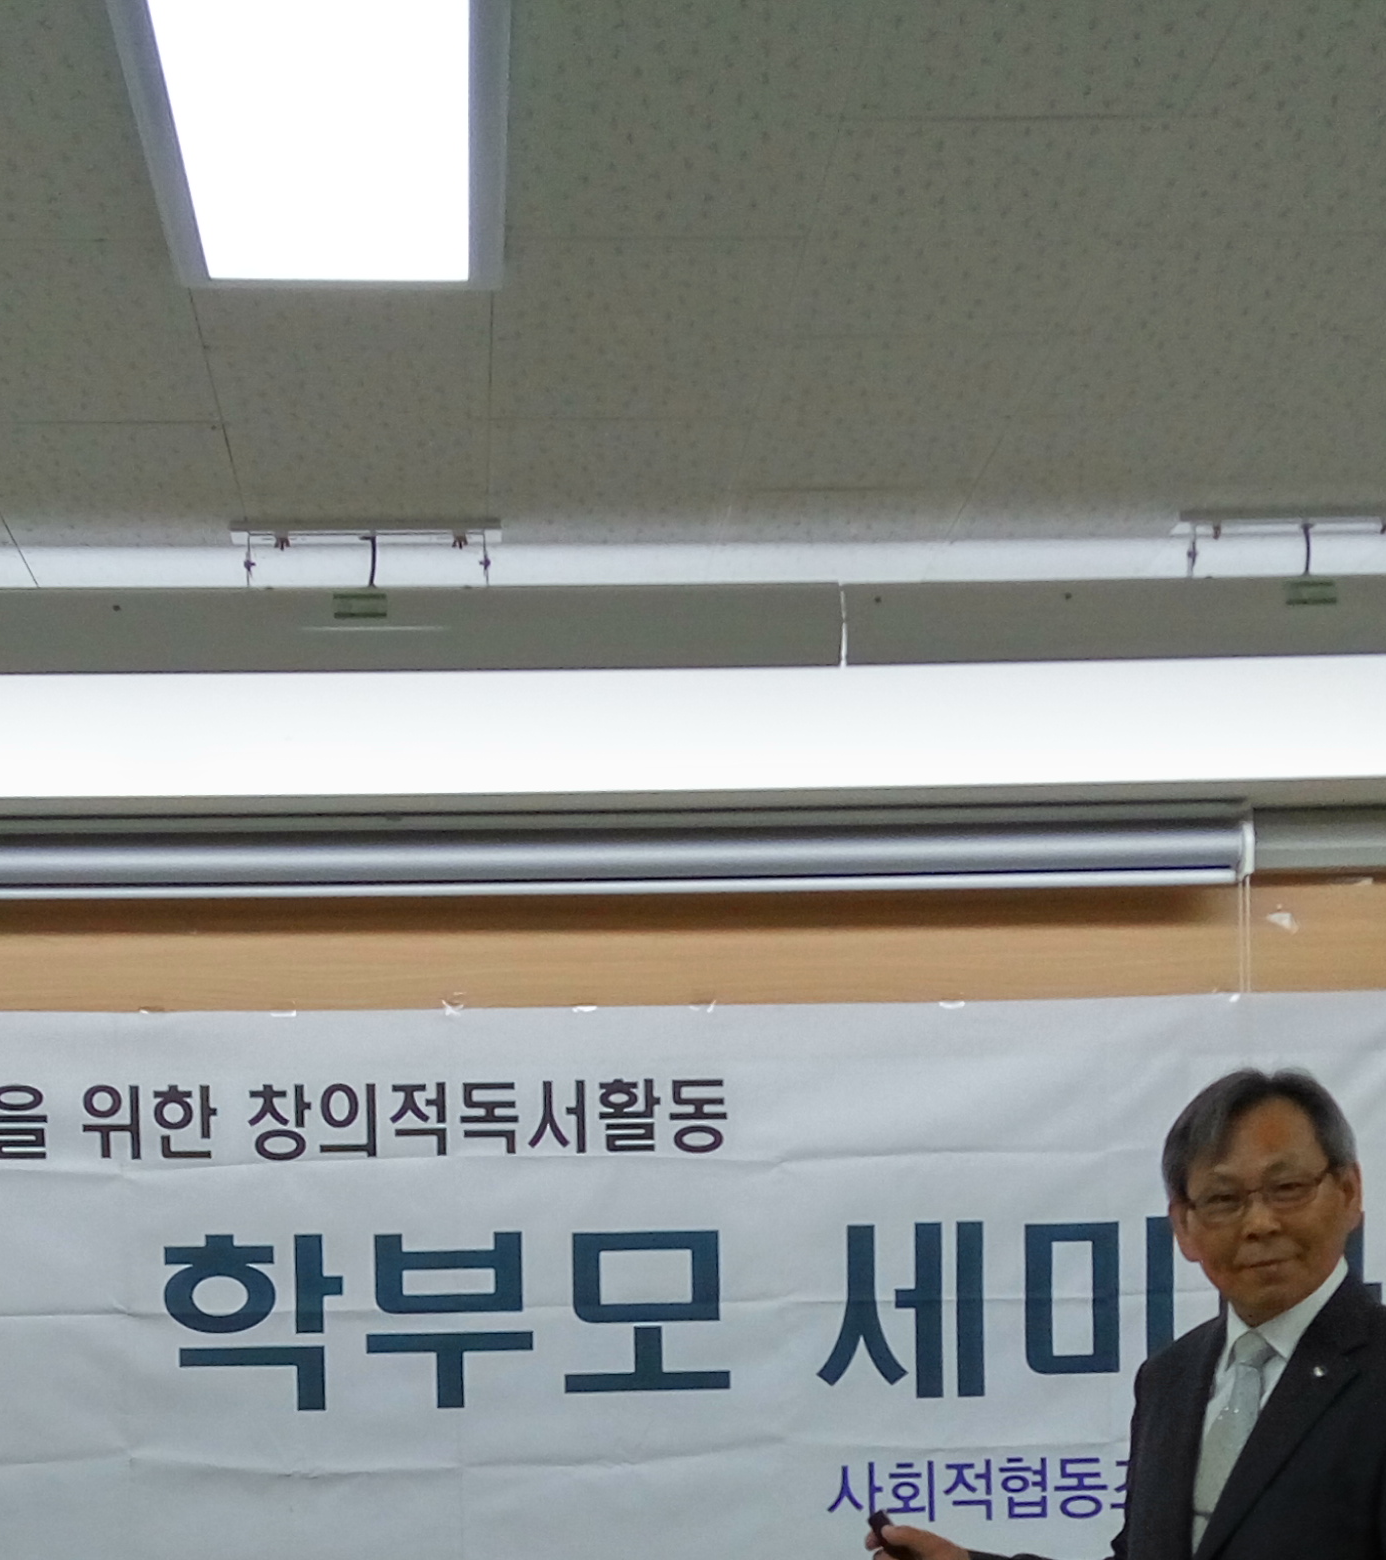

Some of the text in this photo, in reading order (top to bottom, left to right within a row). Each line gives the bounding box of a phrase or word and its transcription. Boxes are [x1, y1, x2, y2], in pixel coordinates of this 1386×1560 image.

[82, 1084, 218, 1161] 위한
[247, 1078, 728, 1161] 창의적독서활동
[164, 1211, 1382, 1411] 학부모 세미
